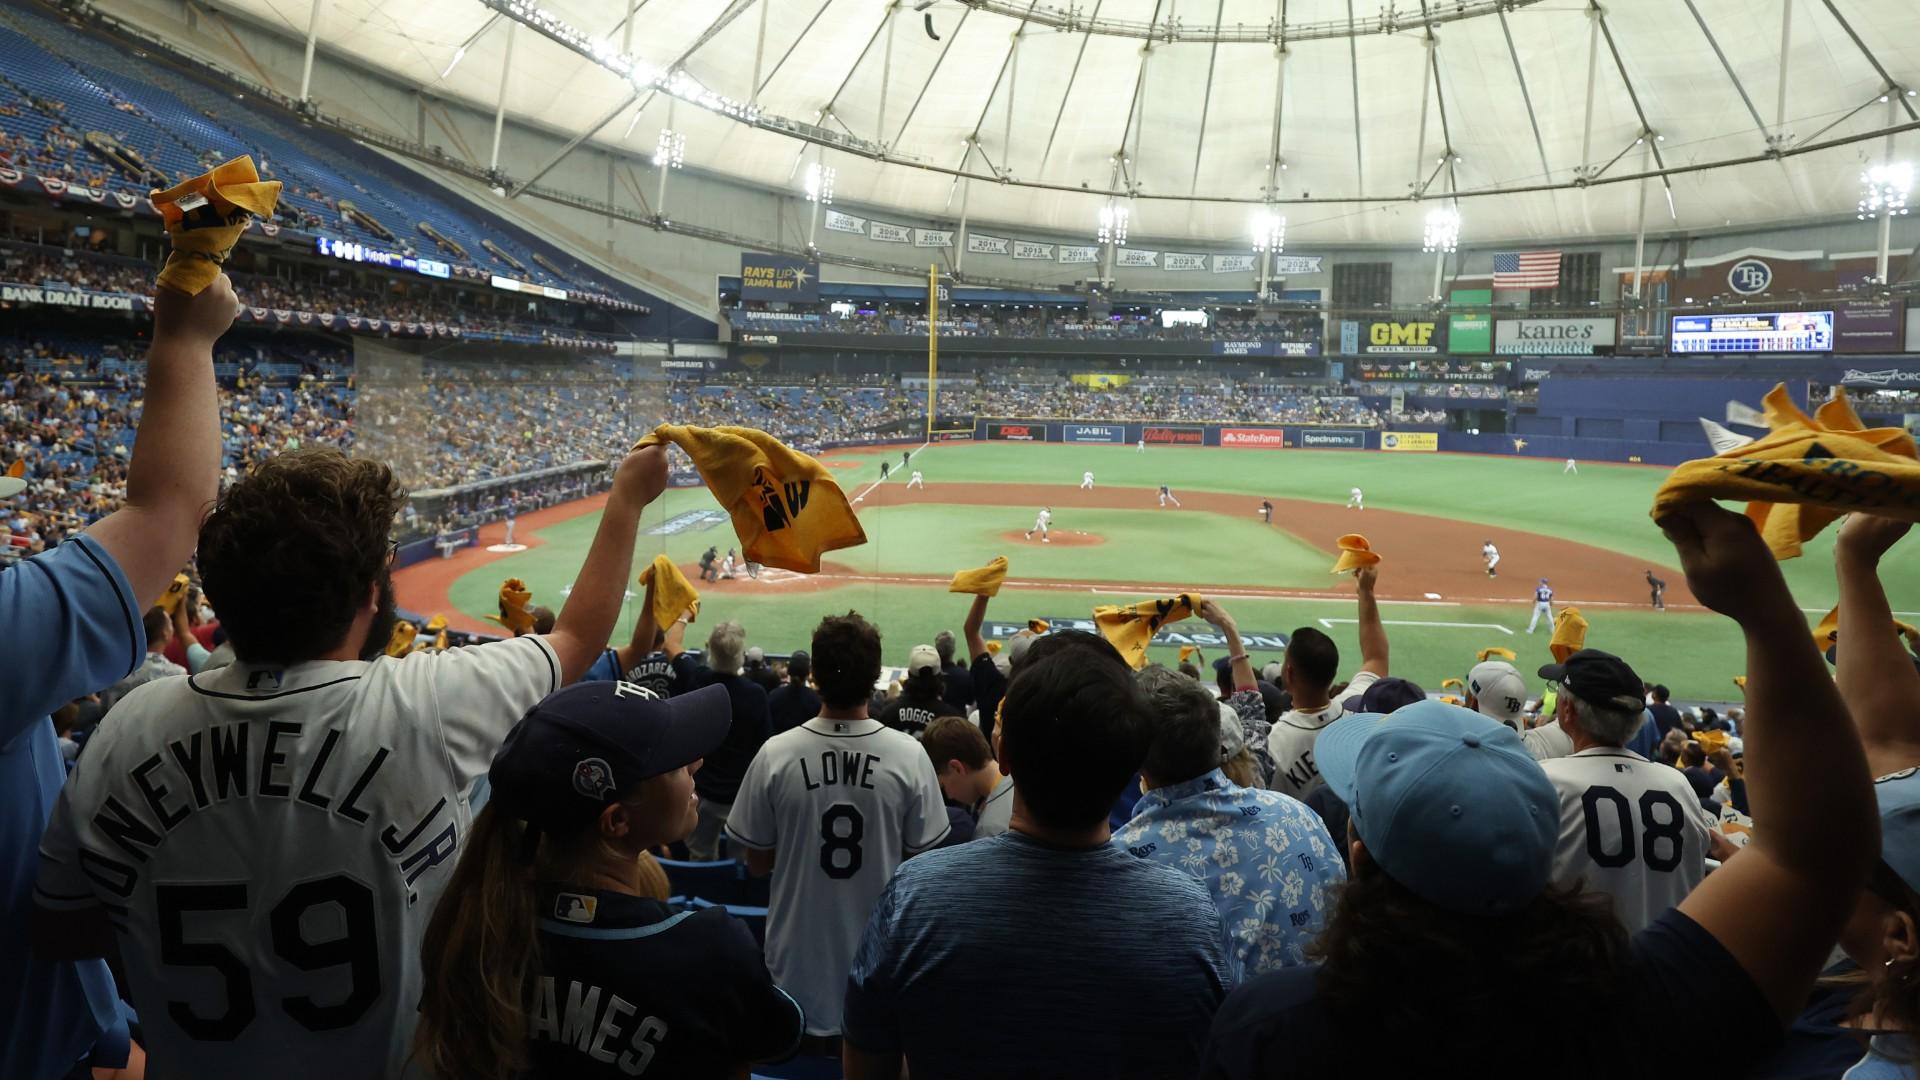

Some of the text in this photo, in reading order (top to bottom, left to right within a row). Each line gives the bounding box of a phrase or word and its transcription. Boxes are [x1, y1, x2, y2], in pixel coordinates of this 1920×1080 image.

[743, 266, 793, 278] RAYS UP
[1737, 266, 1765, 288] TB
[743, 278, 795, 289] TAMPA BAY
[2, 286, 132, 310] BANK DRAFT ROOM
[1370, 321, 1435, 346] GMF
[1517, 321, 1594, 340] kanes
[1000, 425, 1031, 436] DEX
[1076, 427, 1112, 436] JABIL
[1504, 696, 1521, 713] TB
[898, 707, 935, 725] BOGGS
[800, 750, 881, 791] LOWE
[1581, 784, 1685, 873] 08
[380, 797, 457, 907] JR.
[819, 803, 864, 880] 8
[1298, 852, 1314, 873] TB
[154, 873, 382, 1043] 59
[530, 975, 669, 1077] AMES
